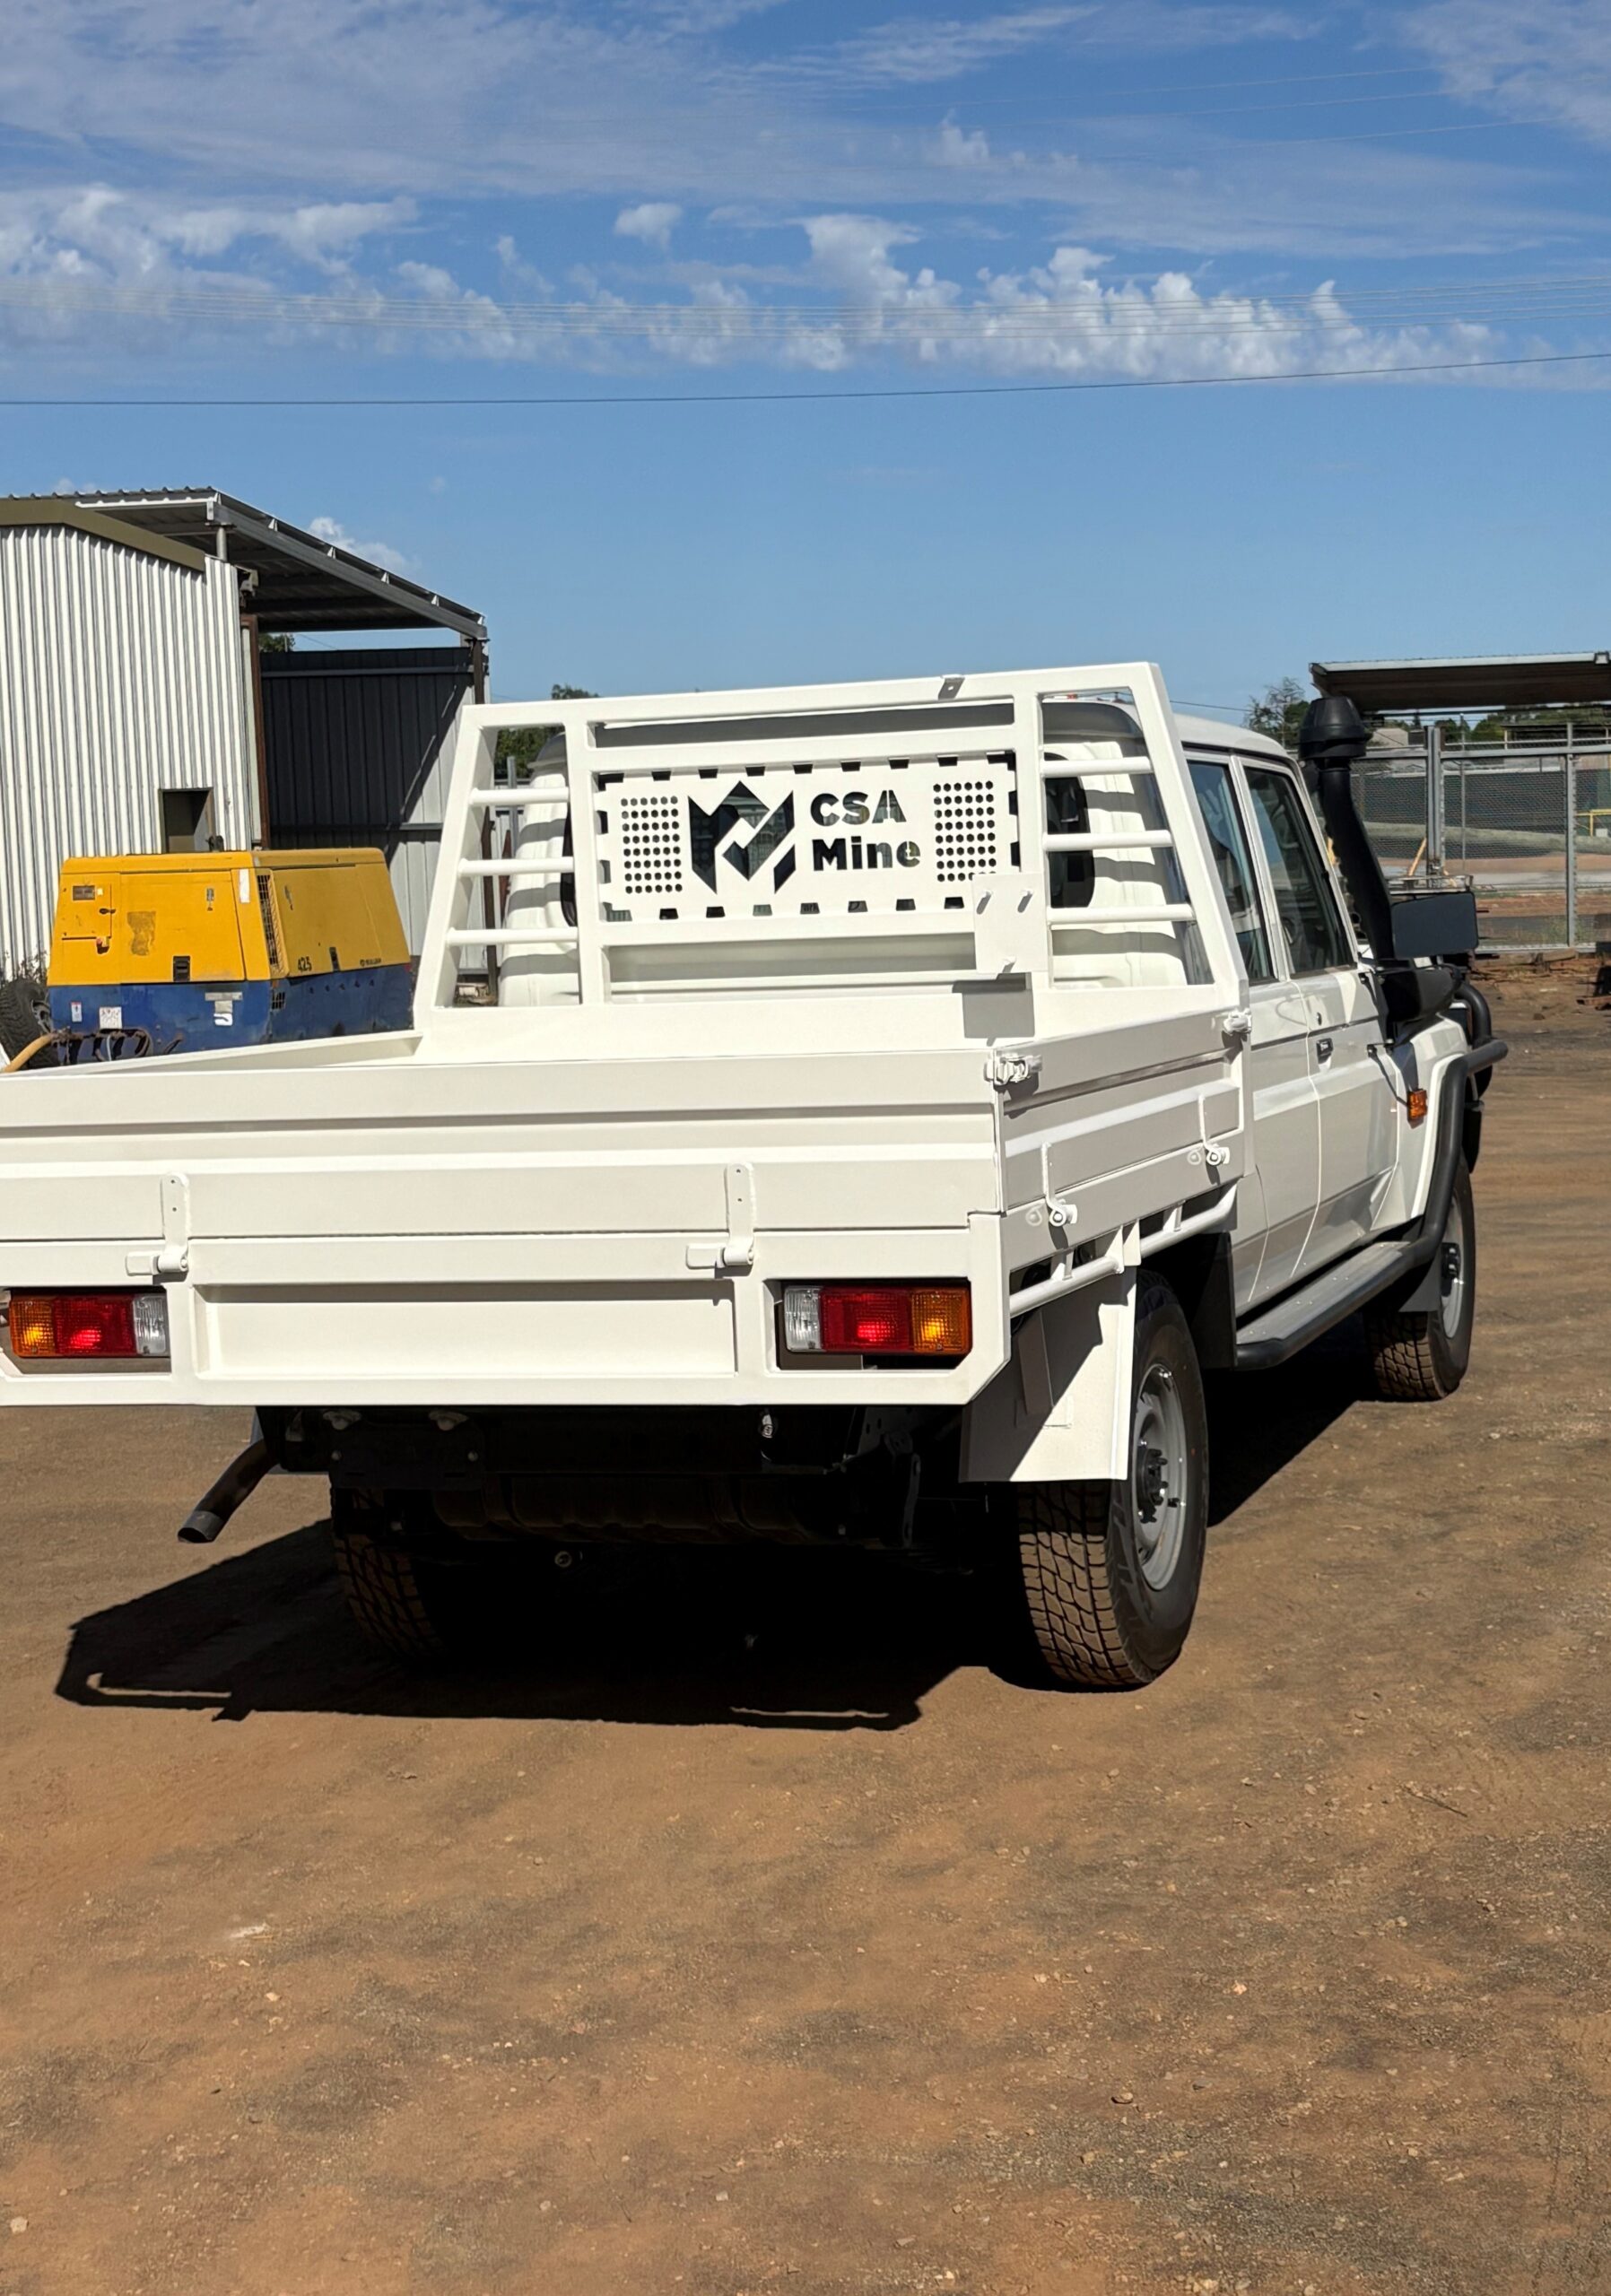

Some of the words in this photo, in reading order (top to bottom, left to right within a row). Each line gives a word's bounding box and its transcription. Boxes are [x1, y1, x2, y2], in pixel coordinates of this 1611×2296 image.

[810, 790, 907, 827] CSA
[812, 836, 921, 871] Mine
[297, 956, 312, 971] 425
